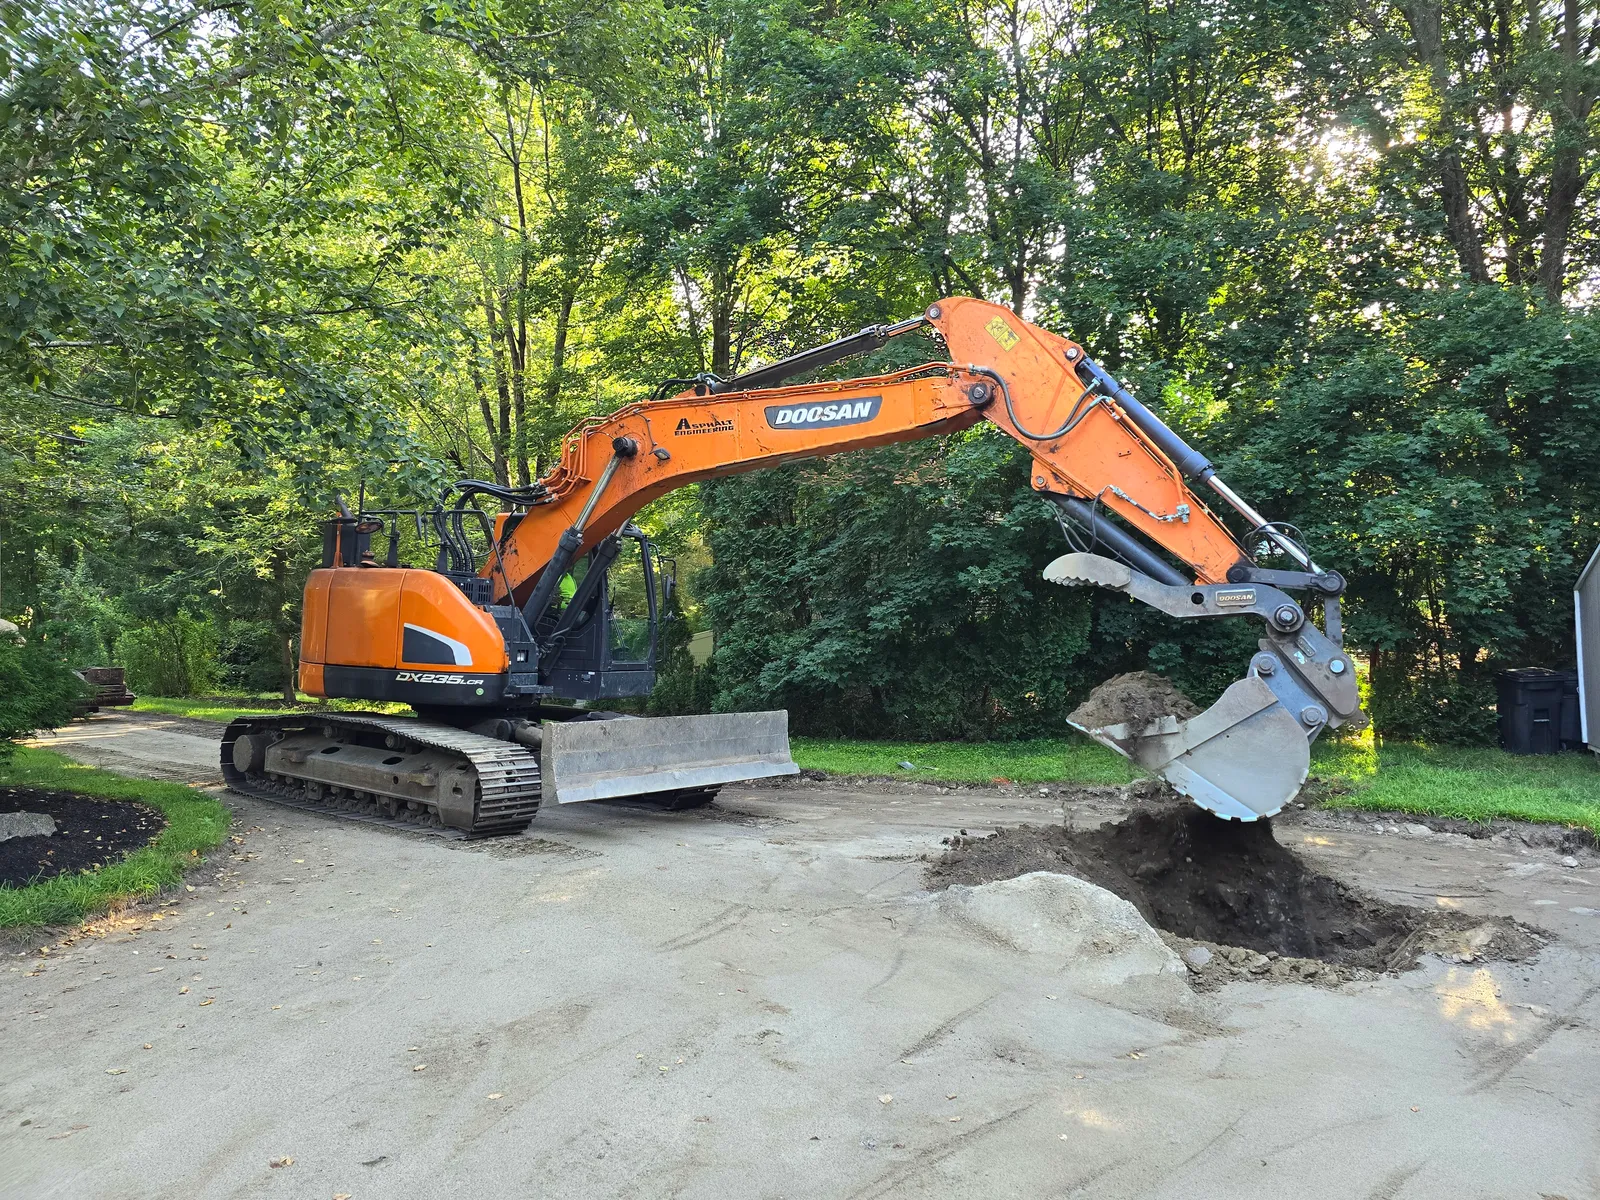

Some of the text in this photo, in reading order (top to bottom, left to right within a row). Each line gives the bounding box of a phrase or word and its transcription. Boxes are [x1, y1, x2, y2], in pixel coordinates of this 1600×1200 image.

[774, 401, 872, 425] DOOSAN
[674, 425, 735, 437] ENGINEERING
[675, 417, 733, 431] ASPHALT
